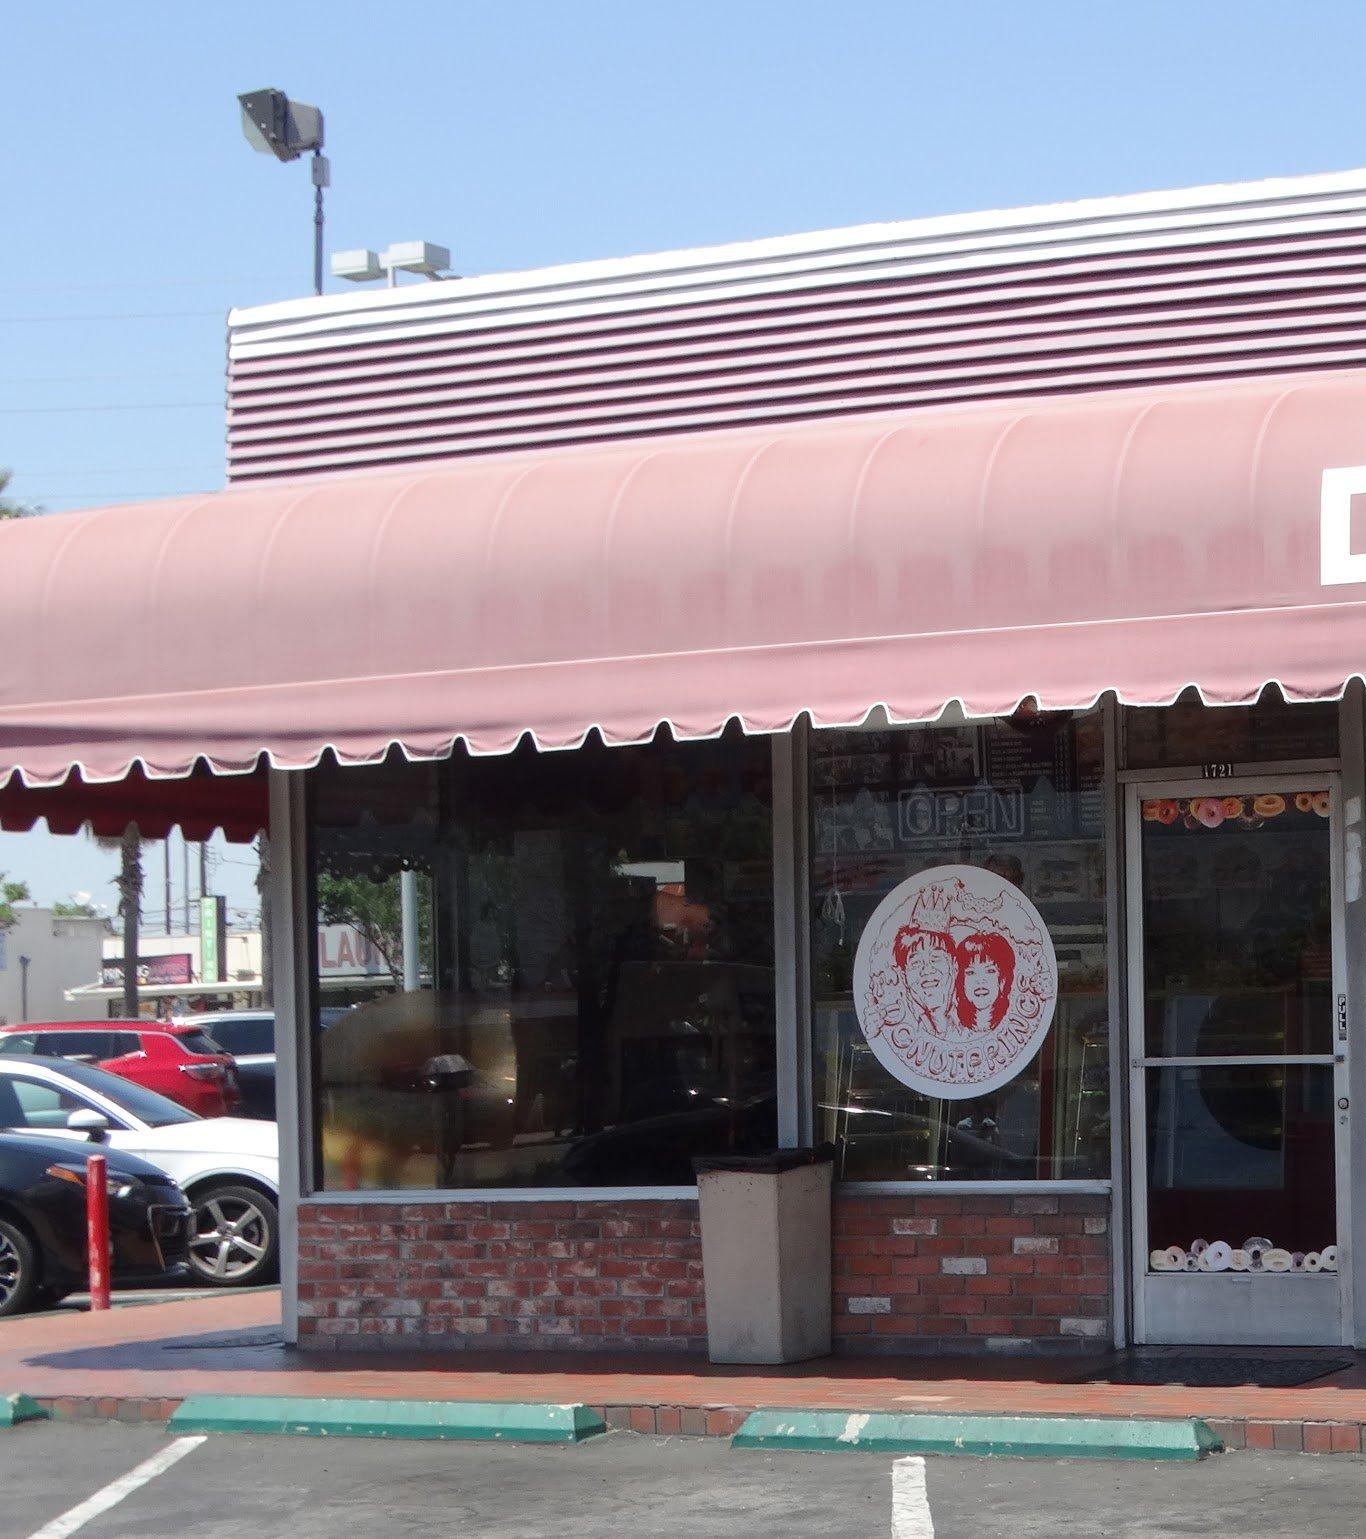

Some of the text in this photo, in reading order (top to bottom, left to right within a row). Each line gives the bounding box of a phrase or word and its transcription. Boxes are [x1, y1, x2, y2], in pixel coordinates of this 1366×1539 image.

[1204, 763, 1233, 778] 1721
[906, 791, 1017, 834] OPEN
[1338, 996, 1346, 1030] PULL
